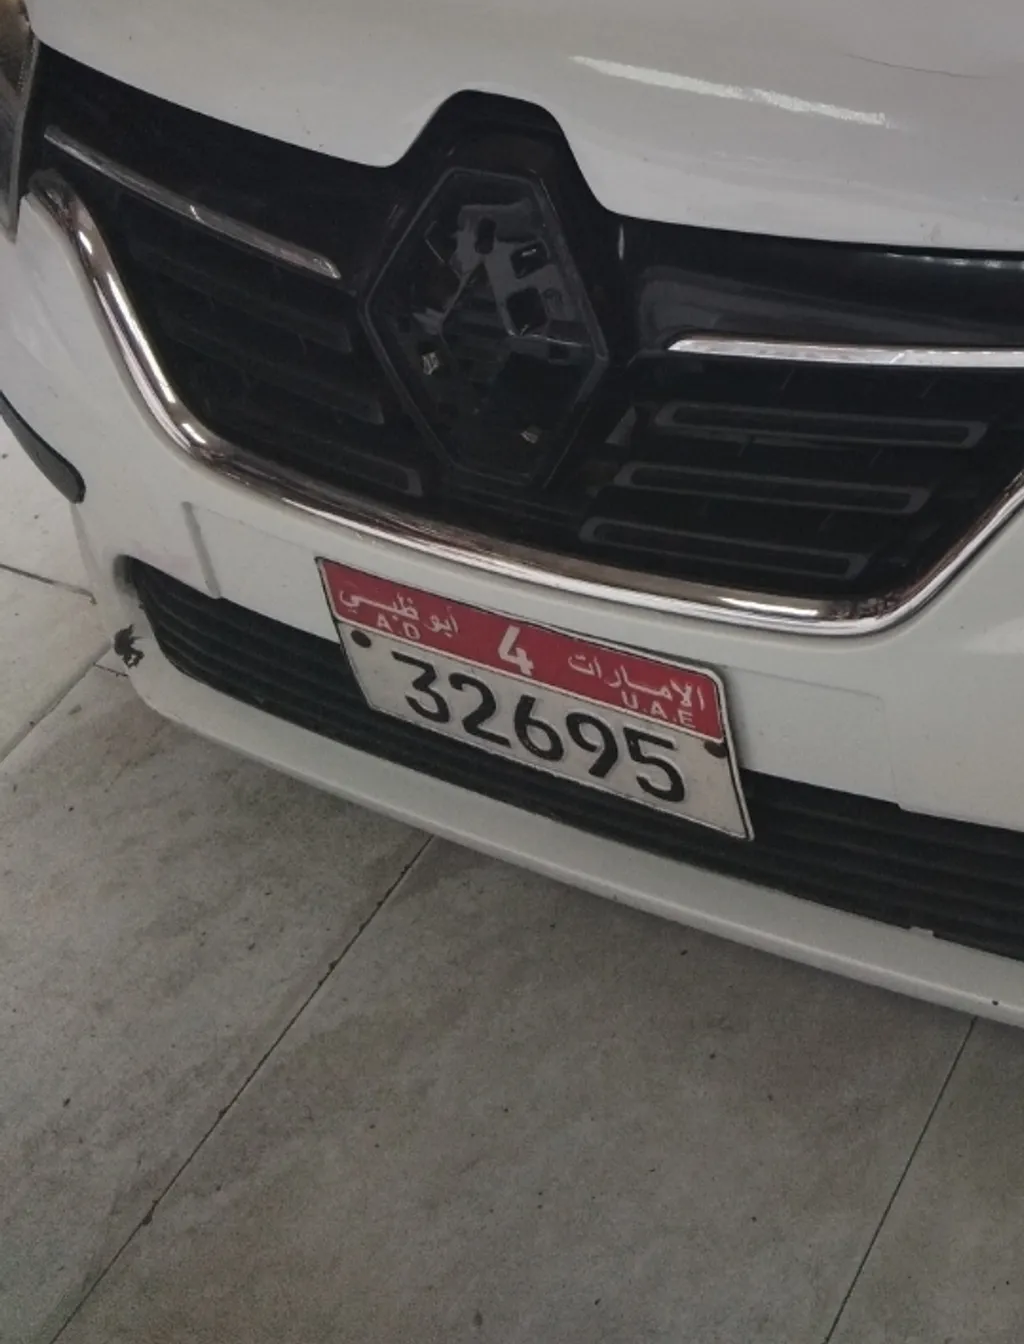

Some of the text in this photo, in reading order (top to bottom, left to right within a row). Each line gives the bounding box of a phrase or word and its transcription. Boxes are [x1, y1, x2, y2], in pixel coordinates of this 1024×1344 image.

[340, 590, 420, 621] ظبي
[497, 625, 535, 677] 4
[391, 650, 686, 803] 32695
